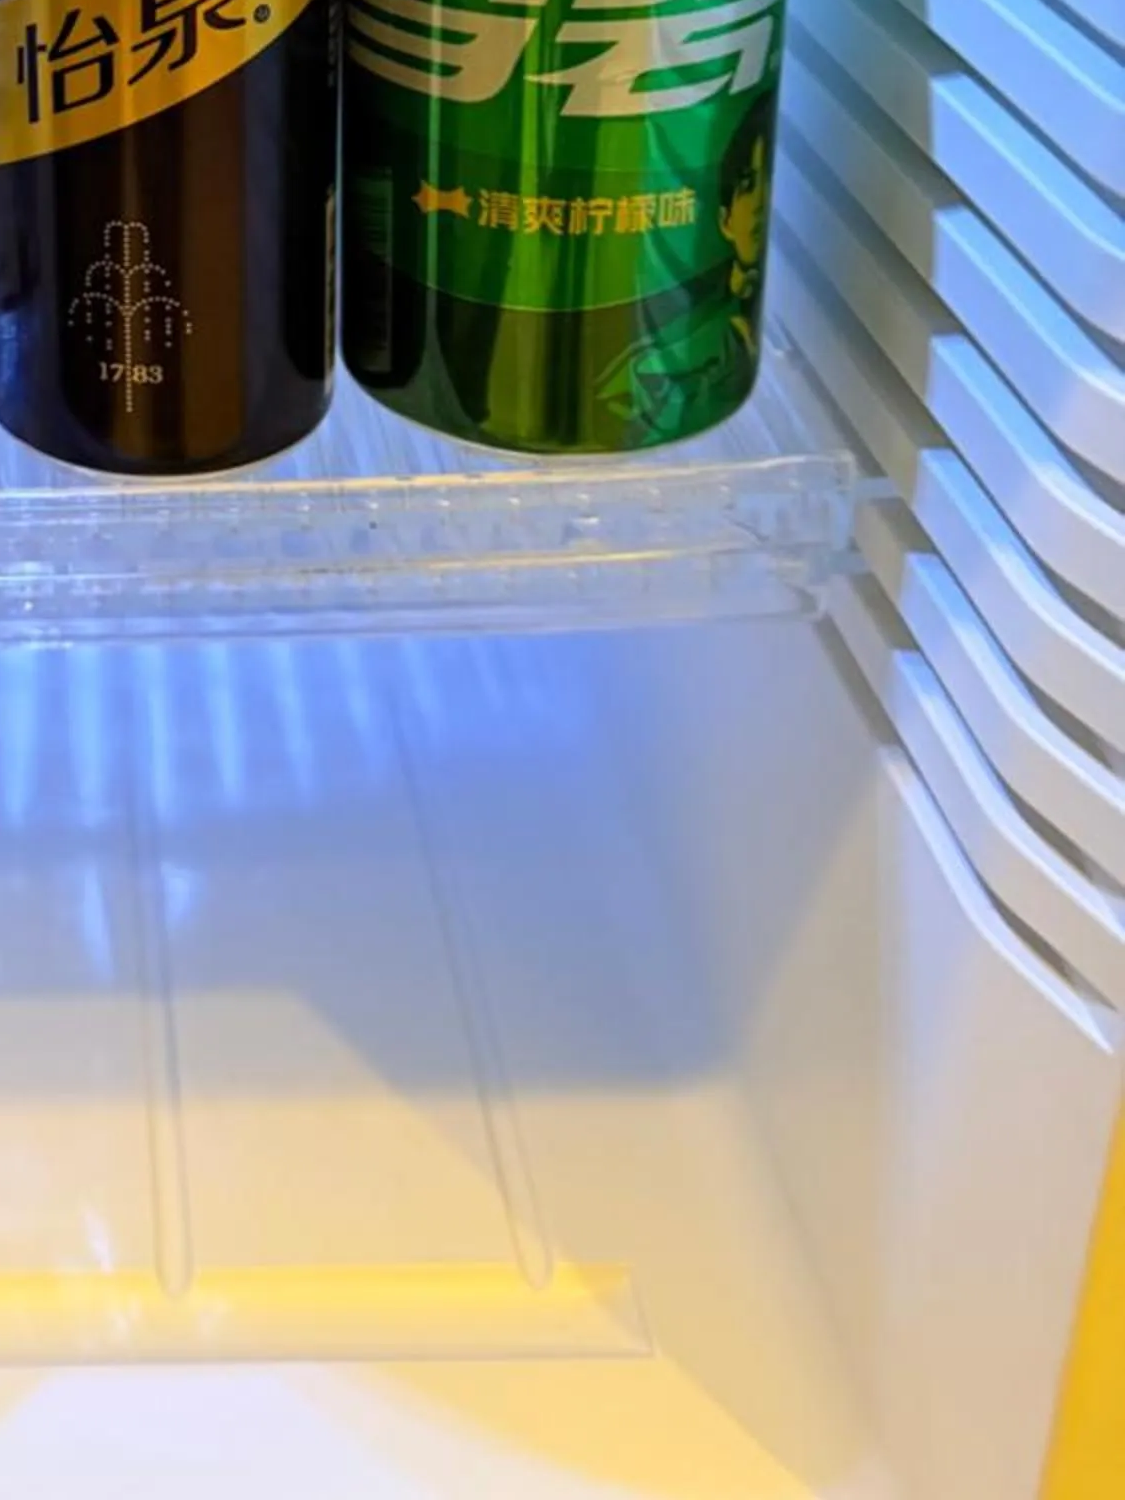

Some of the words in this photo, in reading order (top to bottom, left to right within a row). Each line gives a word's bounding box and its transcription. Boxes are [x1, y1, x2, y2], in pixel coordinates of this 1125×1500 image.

[477, 188, 696, 236] 清爽柠檬味
[99, 361, 164, 384] 1783
